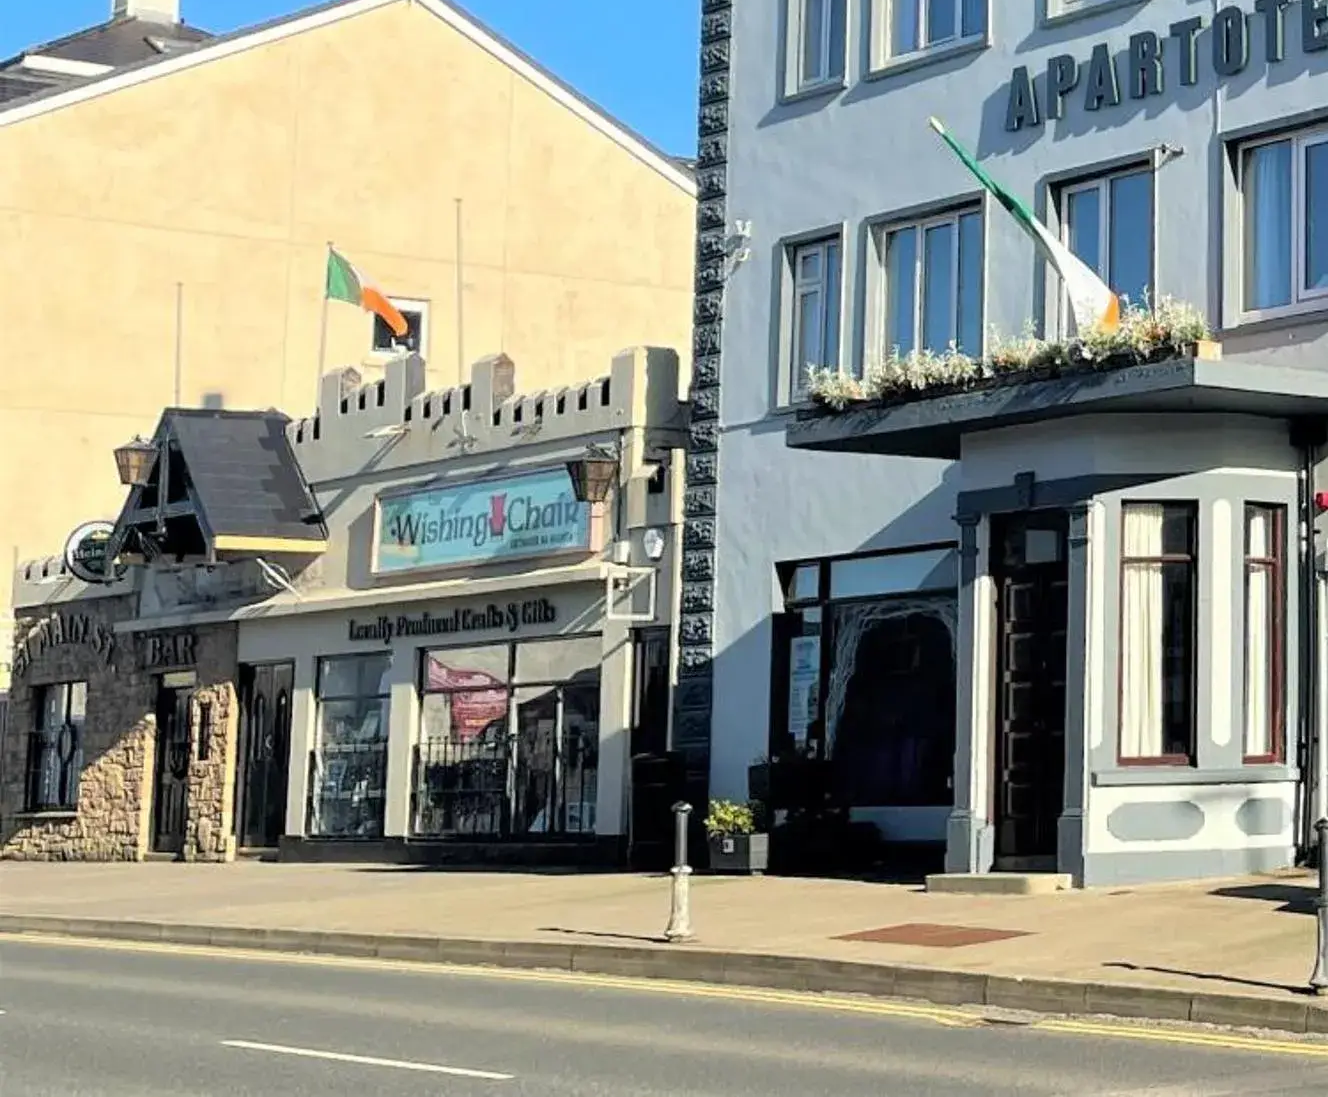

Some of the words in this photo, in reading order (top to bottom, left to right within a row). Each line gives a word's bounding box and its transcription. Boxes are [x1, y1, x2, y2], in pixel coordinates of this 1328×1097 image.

[391, 507, 489, 547] Wishing
[507, 491, 581, 533] Chair
[148, 633, 200, 666] BAR
